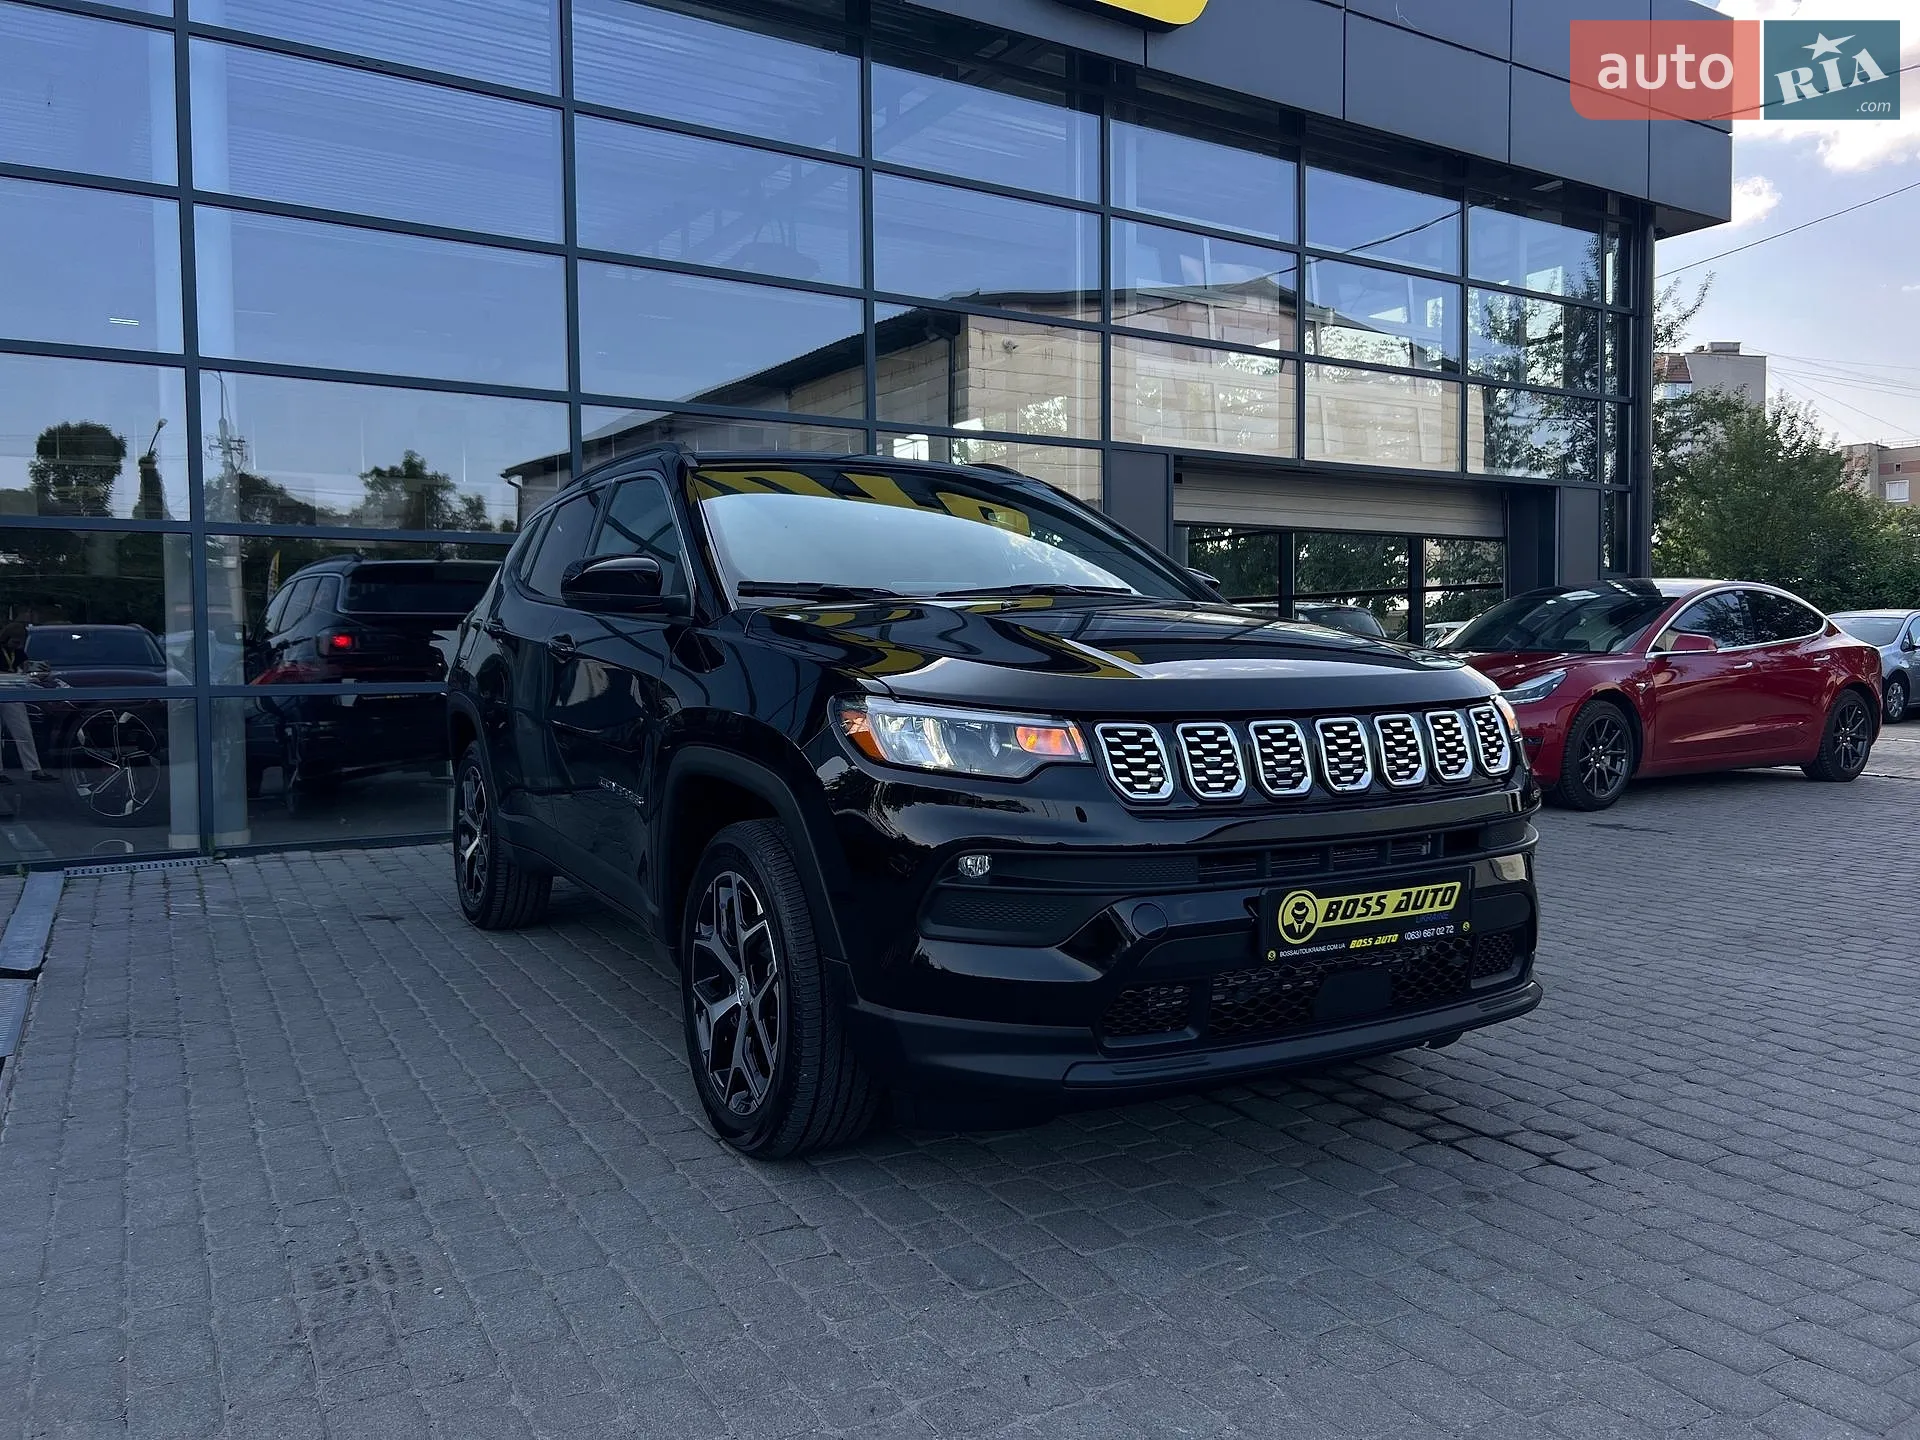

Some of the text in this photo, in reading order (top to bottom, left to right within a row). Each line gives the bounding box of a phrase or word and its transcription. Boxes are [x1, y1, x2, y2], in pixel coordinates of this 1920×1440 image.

[1322, 885, 1457, 923] BOSS AUTO
[1349, 937, 1373, 949] BOSS
[1374, 933, 1399, 945] AUTO
[1445, 924, 1454, 934] 72
